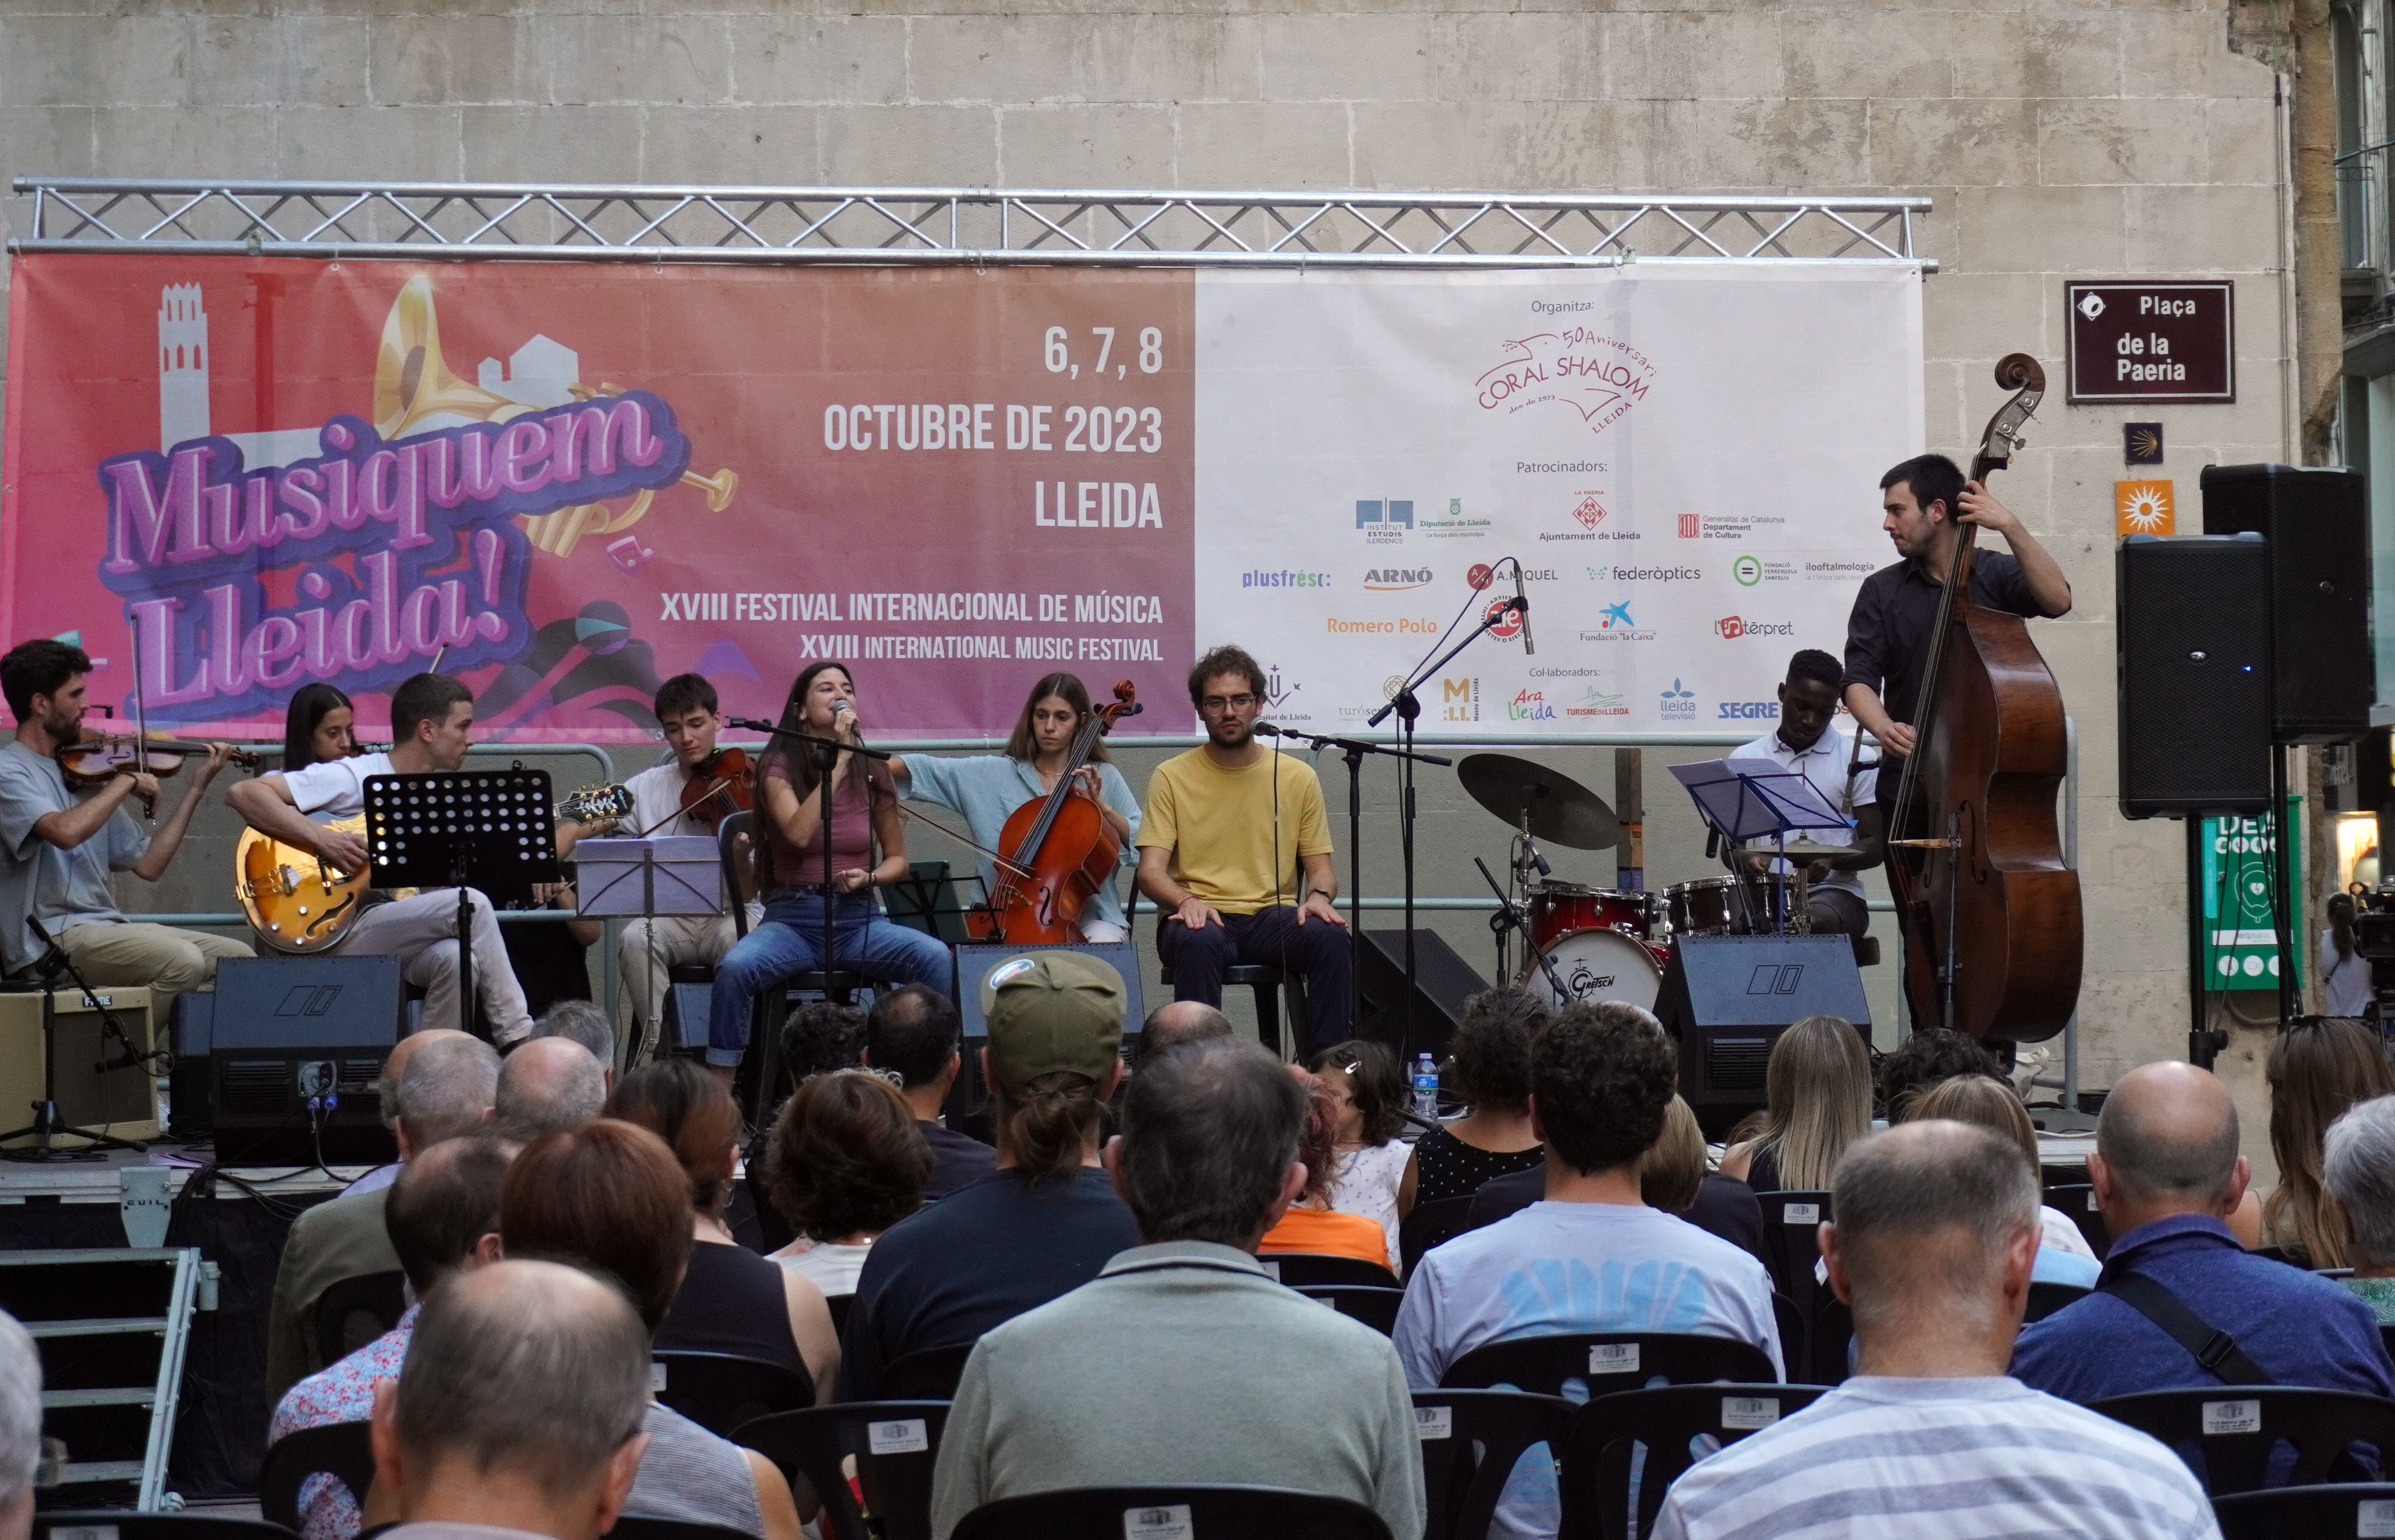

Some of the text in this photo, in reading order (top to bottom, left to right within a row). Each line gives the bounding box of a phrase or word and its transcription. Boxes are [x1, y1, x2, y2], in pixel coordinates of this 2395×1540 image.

[1532, 301, 1594, 315] Organitza:
[2141, 296, 2196, 317] Plaça
[1045, 326, 1163, 381] 6, 7, 8
[1563, 326, 1657, 378] 50 Aniversari
[2118, 332, 2169, 355] de la
[2118, 358, 2186, 381] Paeria
[1478, 356, 1650, 409] CORAL SHALOM
[825, 404, 1163, 453] OCTUBRE DE 2023
[1592, 402, 1633, 433] LLEIDA
[1517, 461, 1608, 473] Patrocinadors:
[105, 400, 663, 573] Musiquem
[1036, 482, 1163, 528] LLEIDA
[1420, 520, 1455, 528] Diputació
[1540, 532, 1595, 542] Ajuntament
[1613, 531, 1641, 540] Lleida
[1613, 566, 1701, 582] federòptics
[1806, 562, 1874, 572] ilooftalmologia
[661, 590, 1163, 623] XVIII FESTIVAL INTERNACIONAL DE MÚSICA
[133, 528, 508, 709] Lleida!
[1328, 617, 1437, 633] Romero Polo
[800, 635, 1164, 661] XVIII INTERNATIONAL MUSIC FESTIVAL
[1513, 688, 1544, 705] Ara
[1661, 700, 1696, 712] lleida
[1508, 701, 1558, 720] Lleida
[1661, 710, 1696, 720] televisió
[1718, 702, 1779, 719] SEGRE
[1572, 973, 1615, 1001] GRETSCH
